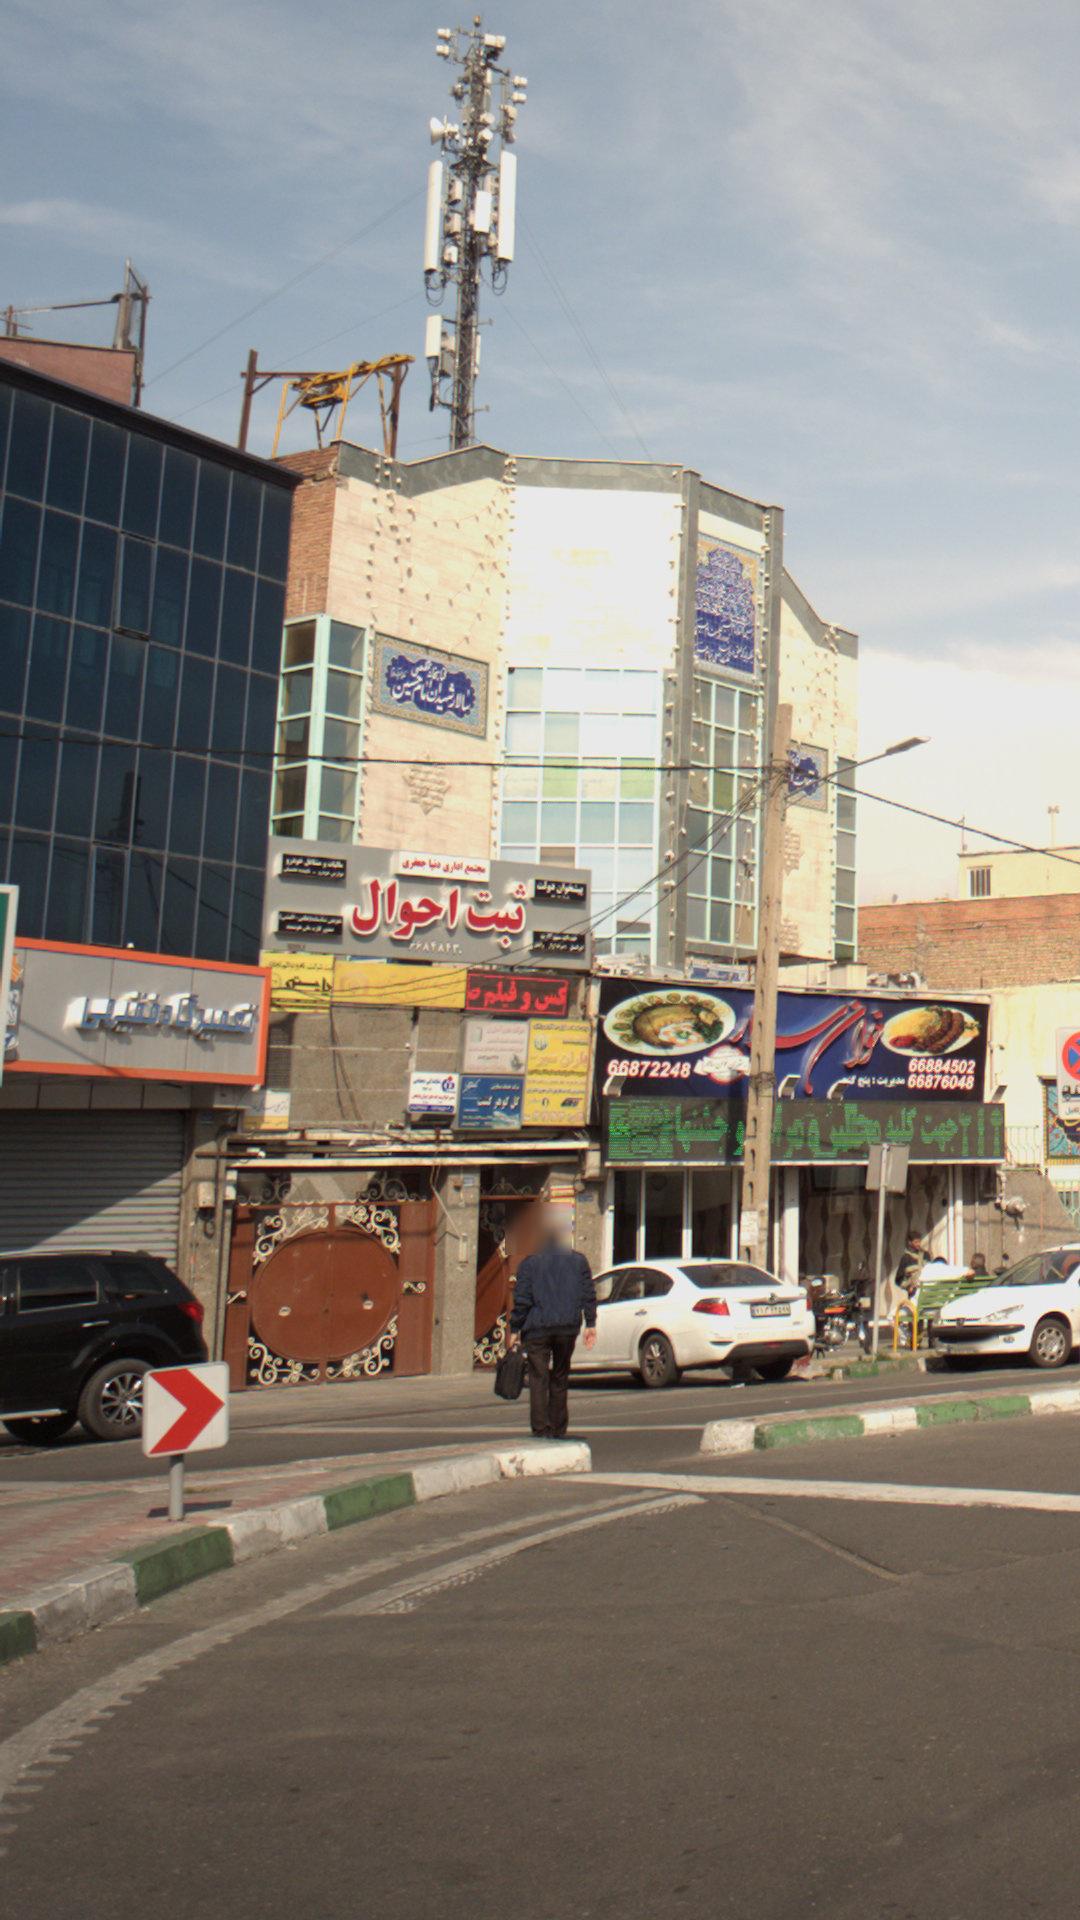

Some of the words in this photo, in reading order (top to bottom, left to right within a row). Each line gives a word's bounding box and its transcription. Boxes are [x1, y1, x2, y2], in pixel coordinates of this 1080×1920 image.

[401, 857, 426, 870] جعفری
[442, 861, 463, 874] اداری
[464, 864, 486, 876] مجتمع
[350, 877, 461, 940] احوال
[466, 881, 526, 949] ثبت
[483, 979, 517, 1009] فیلم
[519, 991, 531, 1012] و
[607, 1058, 691, 1079] 66872248
[907, 1057, 977, 1075] 66884502
[906, 1073, 976, 1091] 66876048
